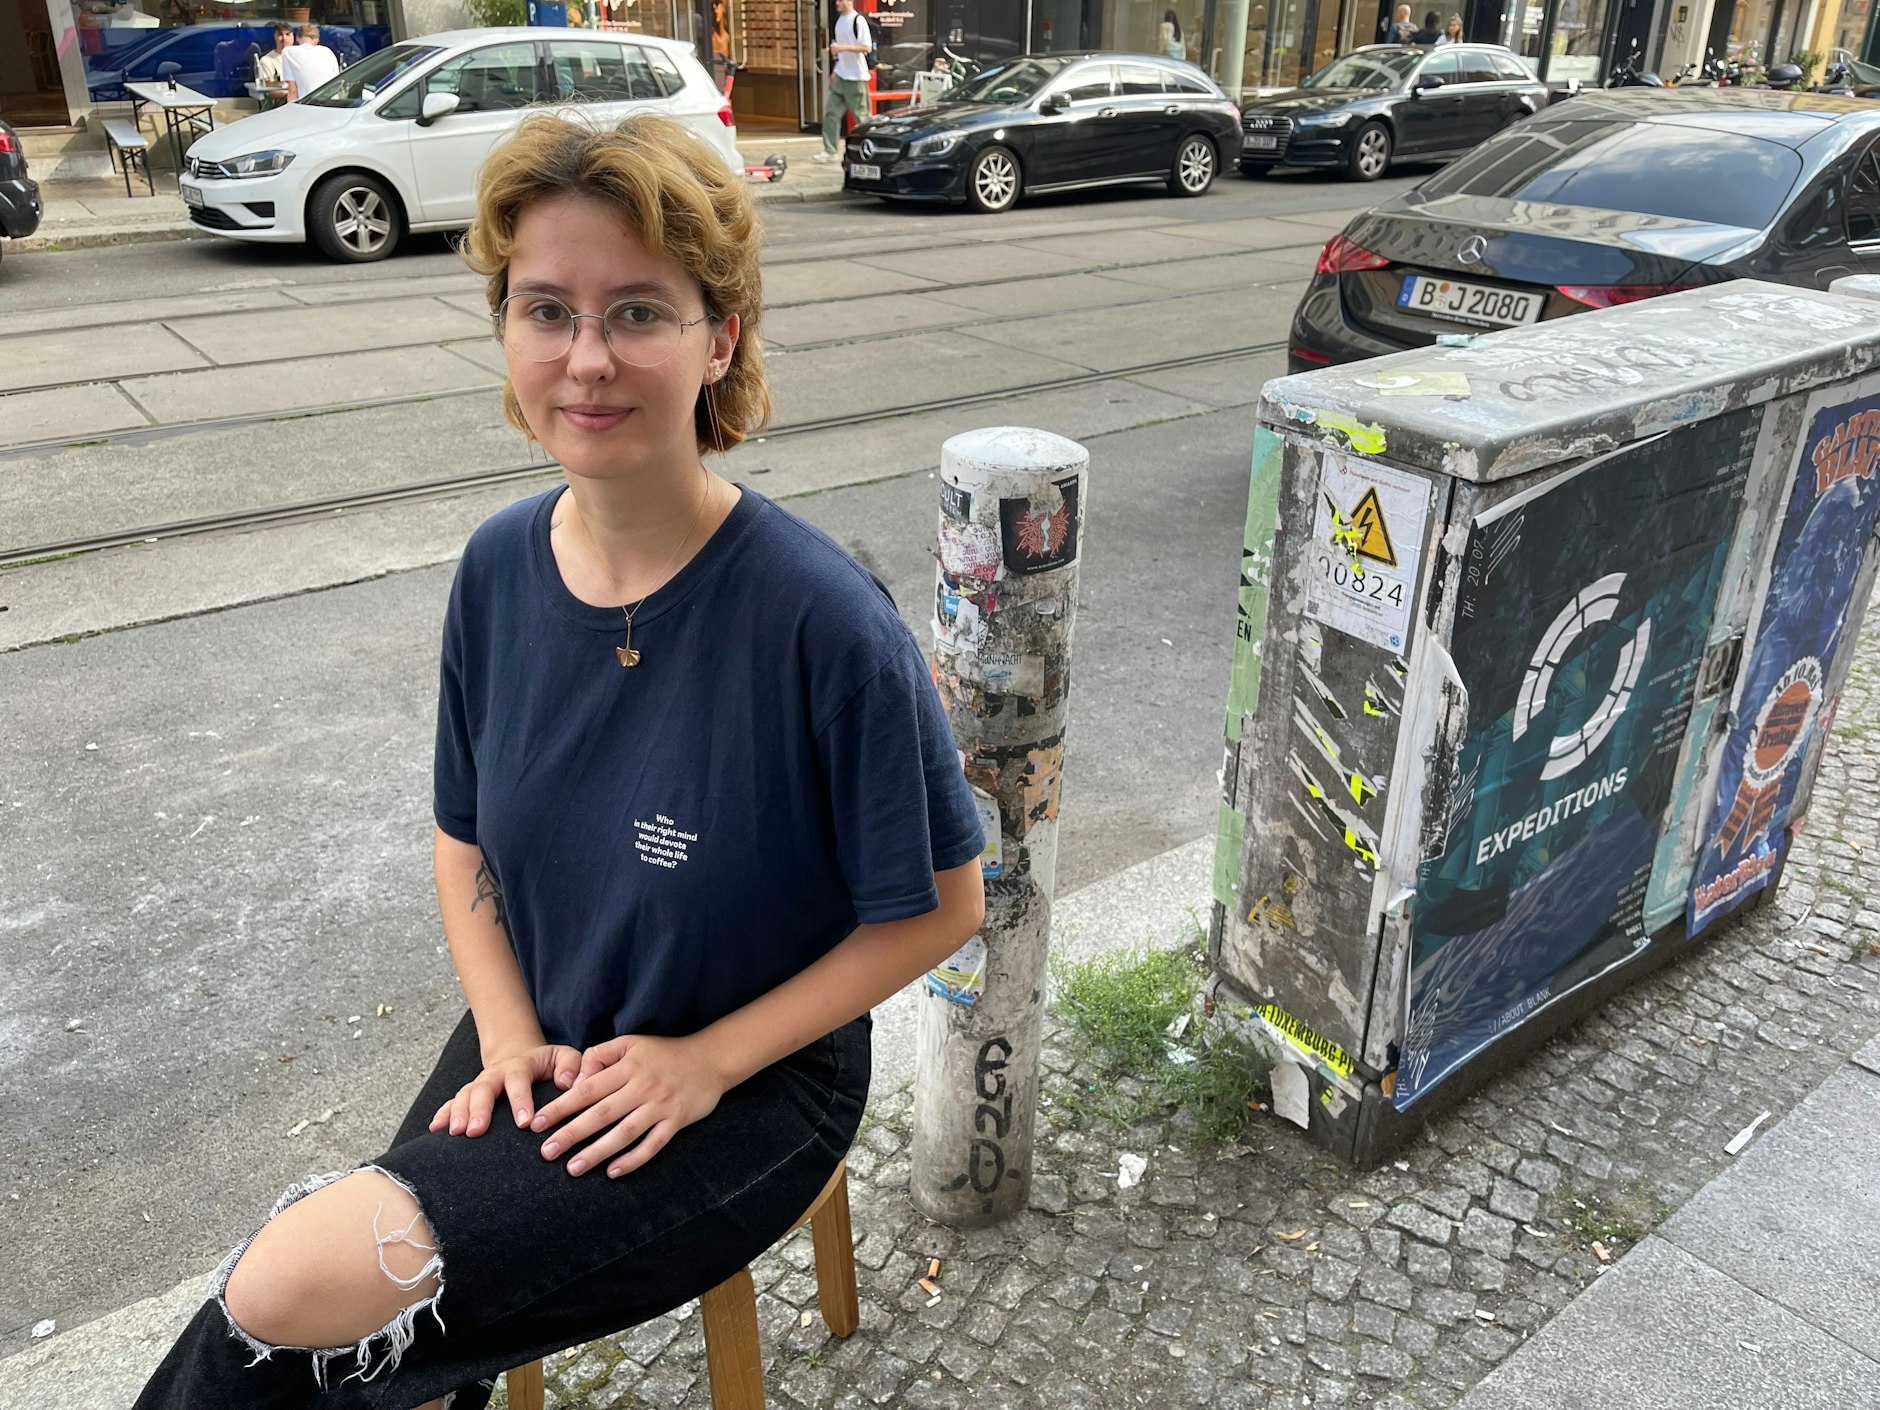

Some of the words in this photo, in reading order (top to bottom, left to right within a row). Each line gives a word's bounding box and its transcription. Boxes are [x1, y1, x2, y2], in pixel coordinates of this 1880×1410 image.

[1419, 281, 1437, 306] B
[1467, 290, 1530, 321] 2080
[1461, 594, 1476, 619] TH:
[656, 813, 675, 826] Who
[1475, 767, 1629, 866] EXPEDITIONS
[633, 818, 641, 828] in
[640, 821, 657, 832] their
[657, 825, 677, 837] right
[677, 831, 698, 842] mind
[638, 832, 659, 843] would
[659, 837, 687, 850] devote
[634, 841, 651, 852] their
[651, 846, 674, 858] whole
[674, 850, 689, 861] life
[640, 853, 648, 862] to
[648, 856, 678, 869] coffee?
[1526, 987, 1553, 1010] BLANK
